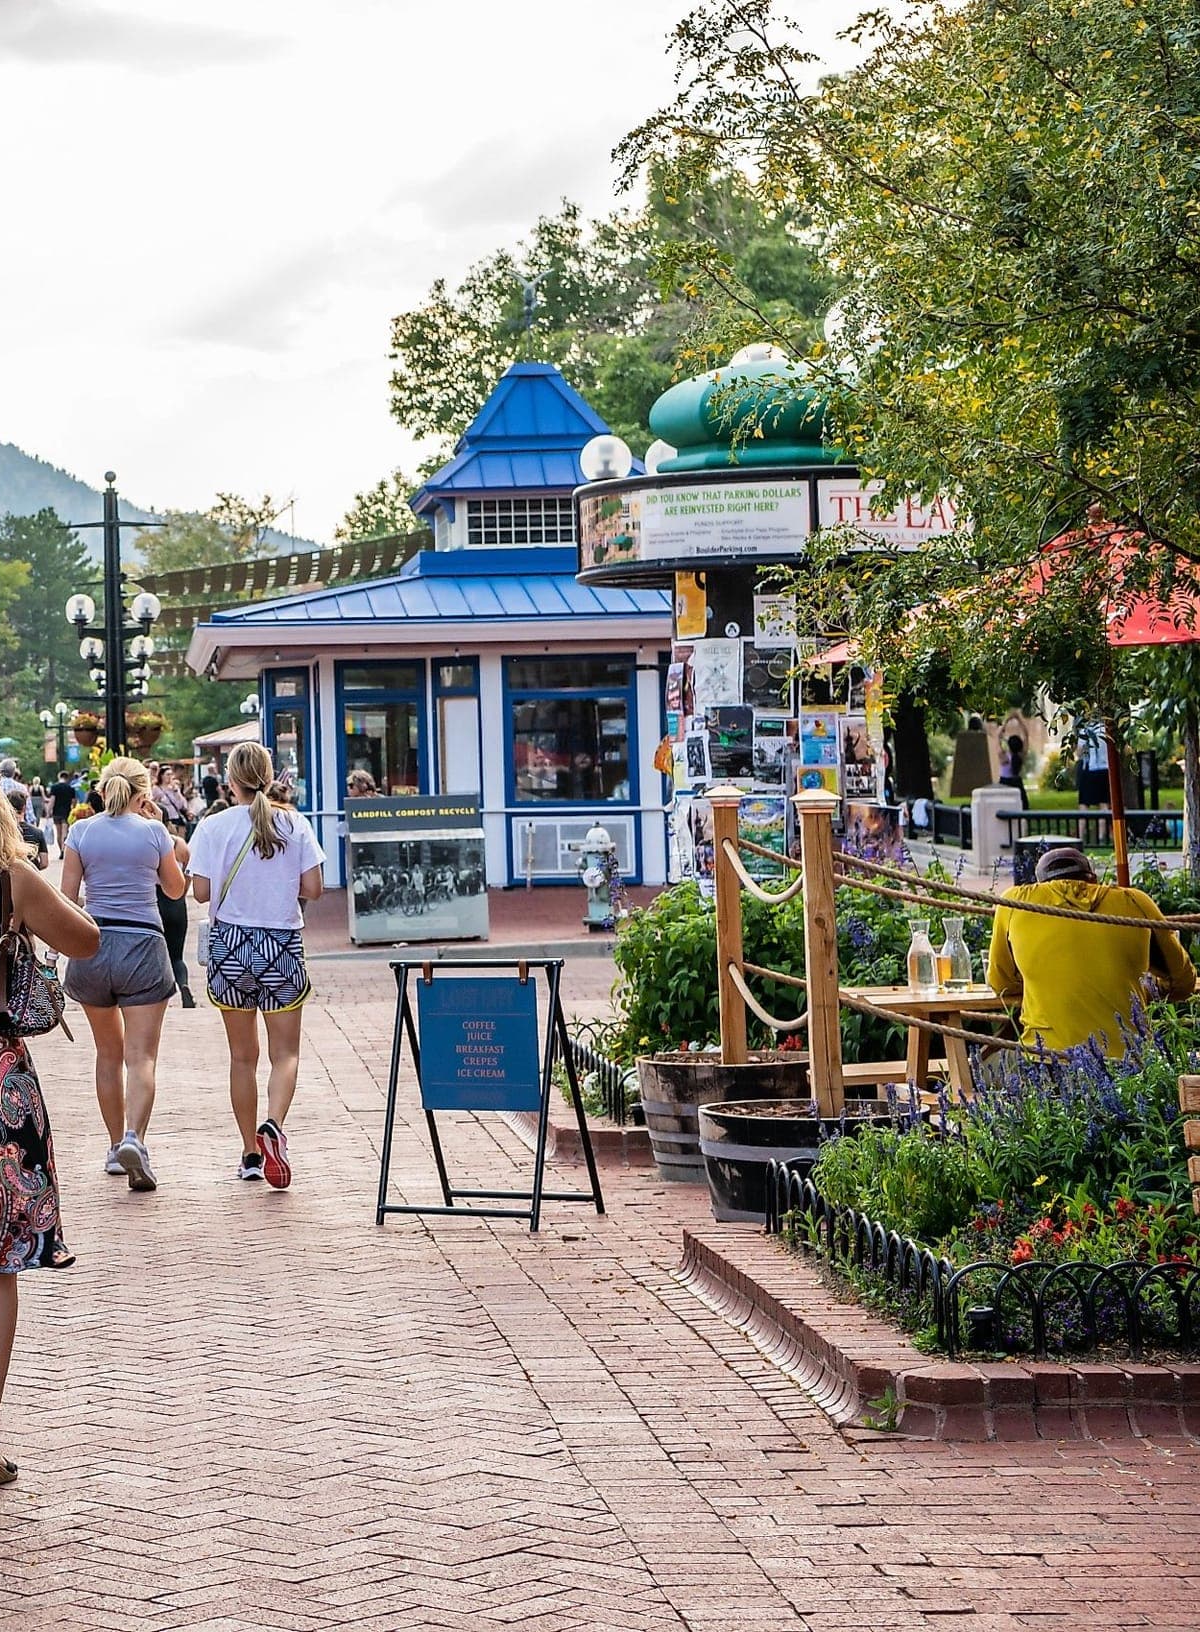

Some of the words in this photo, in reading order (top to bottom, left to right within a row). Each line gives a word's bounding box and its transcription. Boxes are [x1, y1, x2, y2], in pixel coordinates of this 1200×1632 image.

[646, 495, 657, 505] DID
[659, 494, 675, 504] YOU
[675, 492, 701, 502] KNOW
[702, 491, 722, 500] THAT
[724, 489, 761, 500] PARKING
[762, 487, 802, 499] DOLLARS
[664, 506, 679, 516] ARE
[680, 504, 726, 515] REINVESTED
[727, 502, 753, 513] RIGHT
[753, 501, 780, 512] HERE?
[696, 545, 757, 554] BoulderParking.com
[352, 811, 392, 819] LANDFILL
[396, 809, 436, 817] COMPOST
[439, 807, 475, 816] RECYCLE
[462, 1021, 496, 1030] COFFEE
[467, 1032, 493, 1041] JUICE
[455, 1045, 504, 1054] BREAKFAST
[463, 1057, 498, 1066] CREPES
[457, 1069, 473, 1078] ICE
[474, 1069, 505, 1078] CREAM
